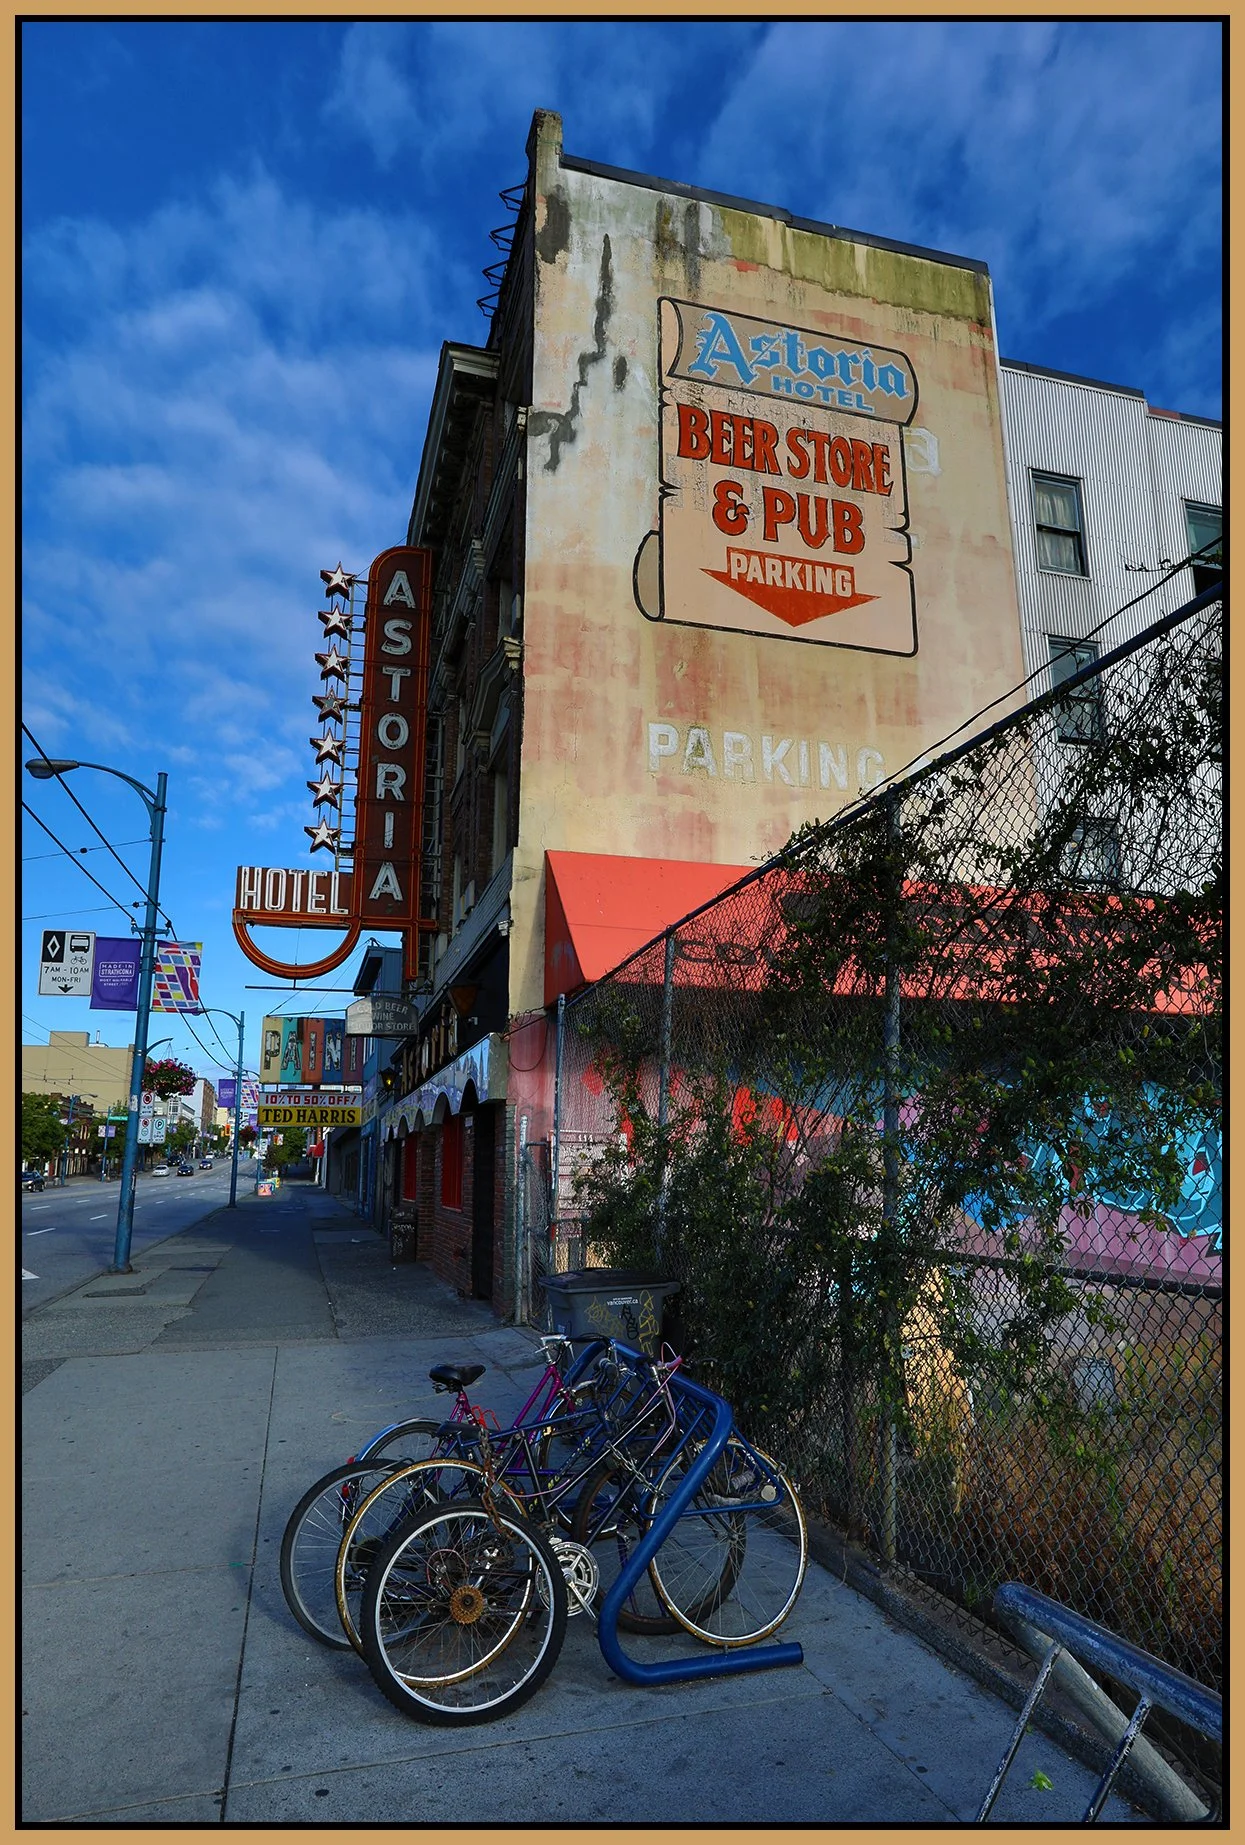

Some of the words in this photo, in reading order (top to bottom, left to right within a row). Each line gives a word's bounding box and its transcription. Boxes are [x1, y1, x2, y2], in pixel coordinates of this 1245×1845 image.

[688, 311, 910, 399] Astoria
[770, 375, 875, 412] HOTEL
[677, 402, 783, 476] BEER
[786, 427, 894, 496] STORE
[712, 480, 750, 536] &
[762, 485, 866, 556] PUB
[730, 551, 853, 597] PARKING
[368, 570, 416, 901] ASTORIA
[648, 723, 886, 792] PARKING
[239, 866, 349, 915] HOTEL
[385, 1002, 408, 1014] BEER
[385, 1022, 414, 1031] STORE
[262, 1109, 293, 1122] TED
[296, 1109, 356, 1123] HARRIS
[265, 1095, 285, 1104] 10%
[287, 1095, 301, 1104] TO
[304, 1095, 326, 1105] 50%
[328, 1095, 357, 1105] OFF!
